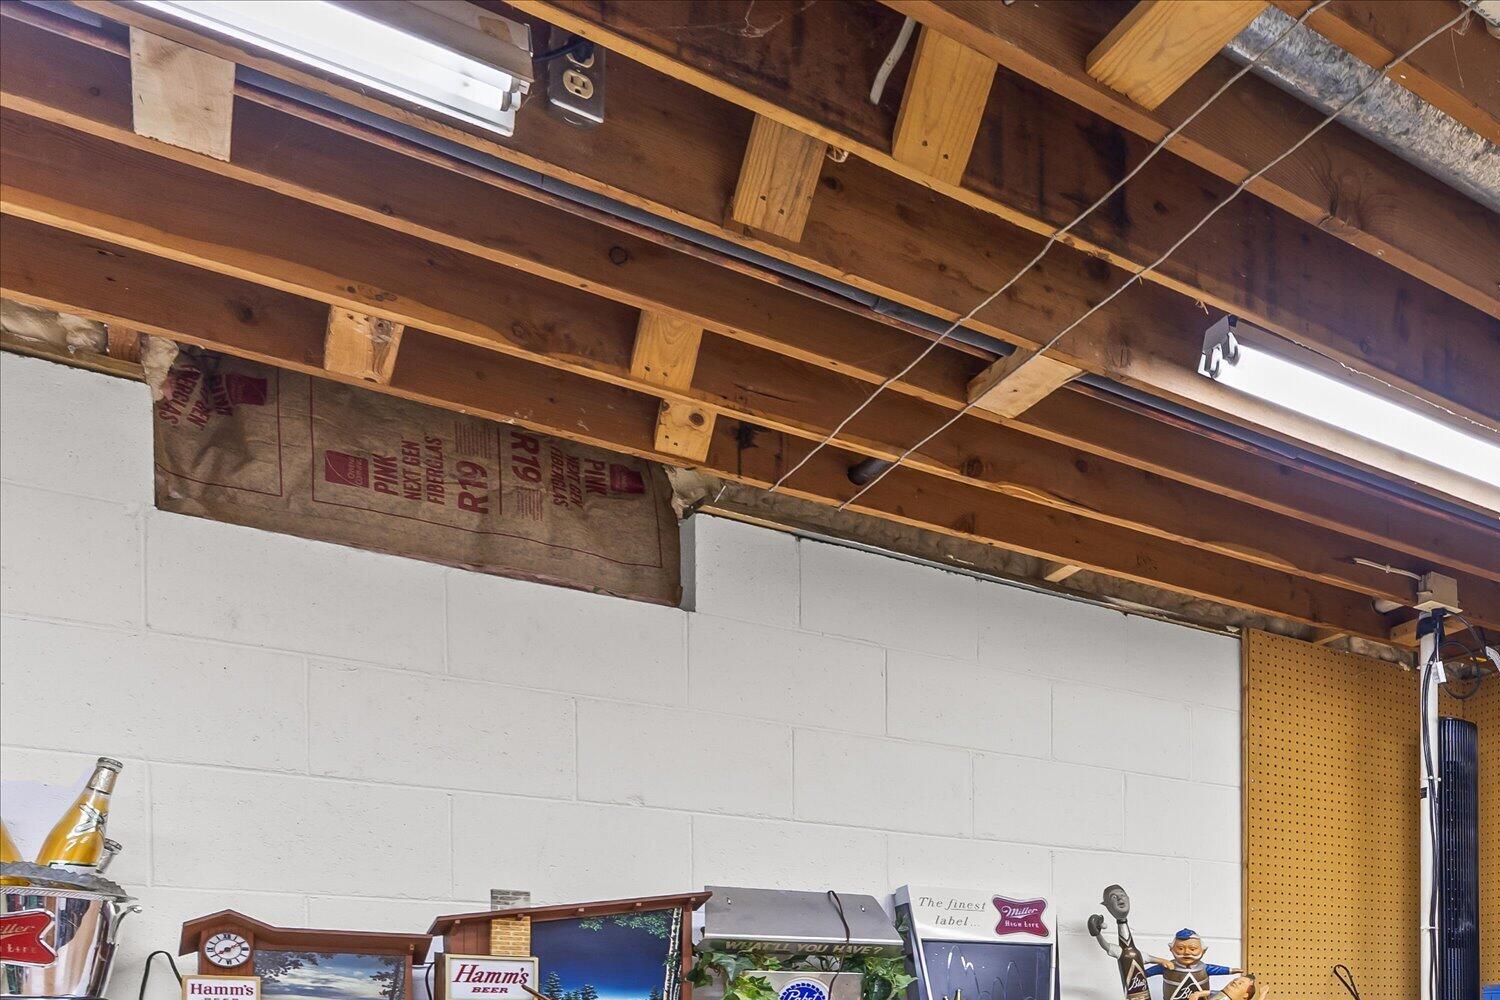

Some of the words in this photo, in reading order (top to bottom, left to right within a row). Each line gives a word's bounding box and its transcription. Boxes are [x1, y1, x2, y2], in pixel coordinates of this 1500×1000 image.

[401, 440, 421, 466] GEN
[511, 430, 542, 483] R19
[372, 453, 399, 496] PINK
[402, 468, 422, 501] NEXT
[425, 435, 445, 505] FIBERGLAS
[584, 458, 608, 496] PINK
[456, 460, 489, 514] R19
[919, 897, 943, 908] The
[945, 898, 986, 911] finest
[1002, 905, 1038, 917] Miller
[797, 944, 829, 953] YOU
[452, 963, 529, 985] Hamm's
[190, 982, 254, 996] Hamm's
